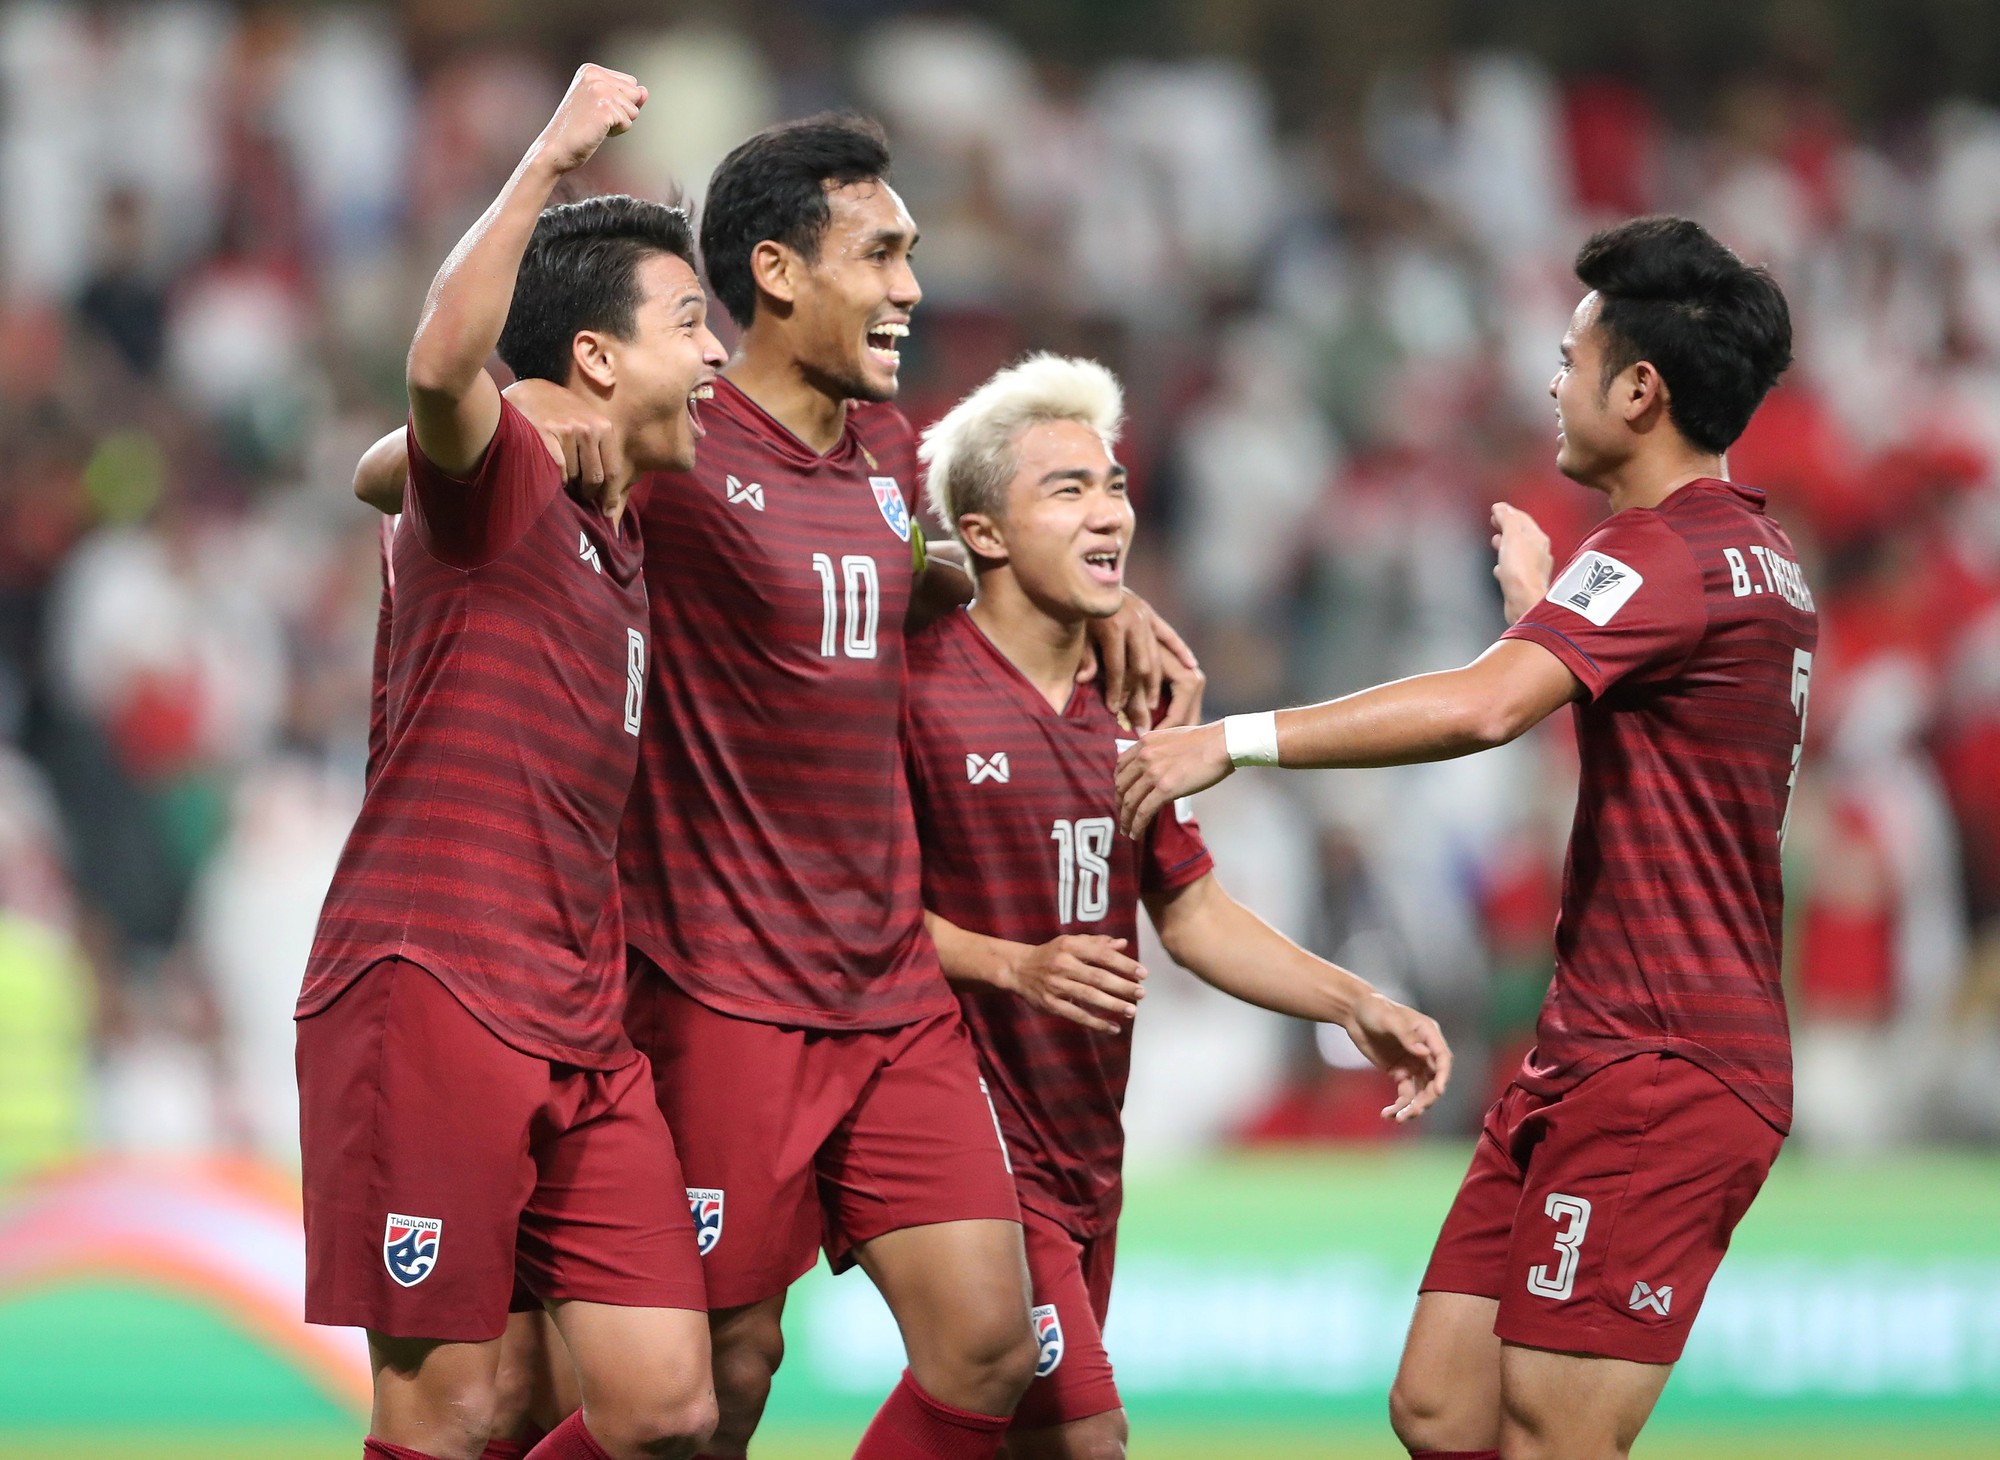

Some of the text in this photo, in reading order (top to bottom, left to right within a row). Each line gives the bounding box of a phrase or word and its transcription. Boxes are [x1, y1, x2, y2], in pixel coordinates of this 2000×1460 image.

[812, 553, 880, 659] 10
[1050, 816, 1115, 925] 18
[390, 1216, 439, 1230] THAILAND
[687, 1191, 721, 1201] AILAND
[1526, 1192, 1592, 1301] 3
